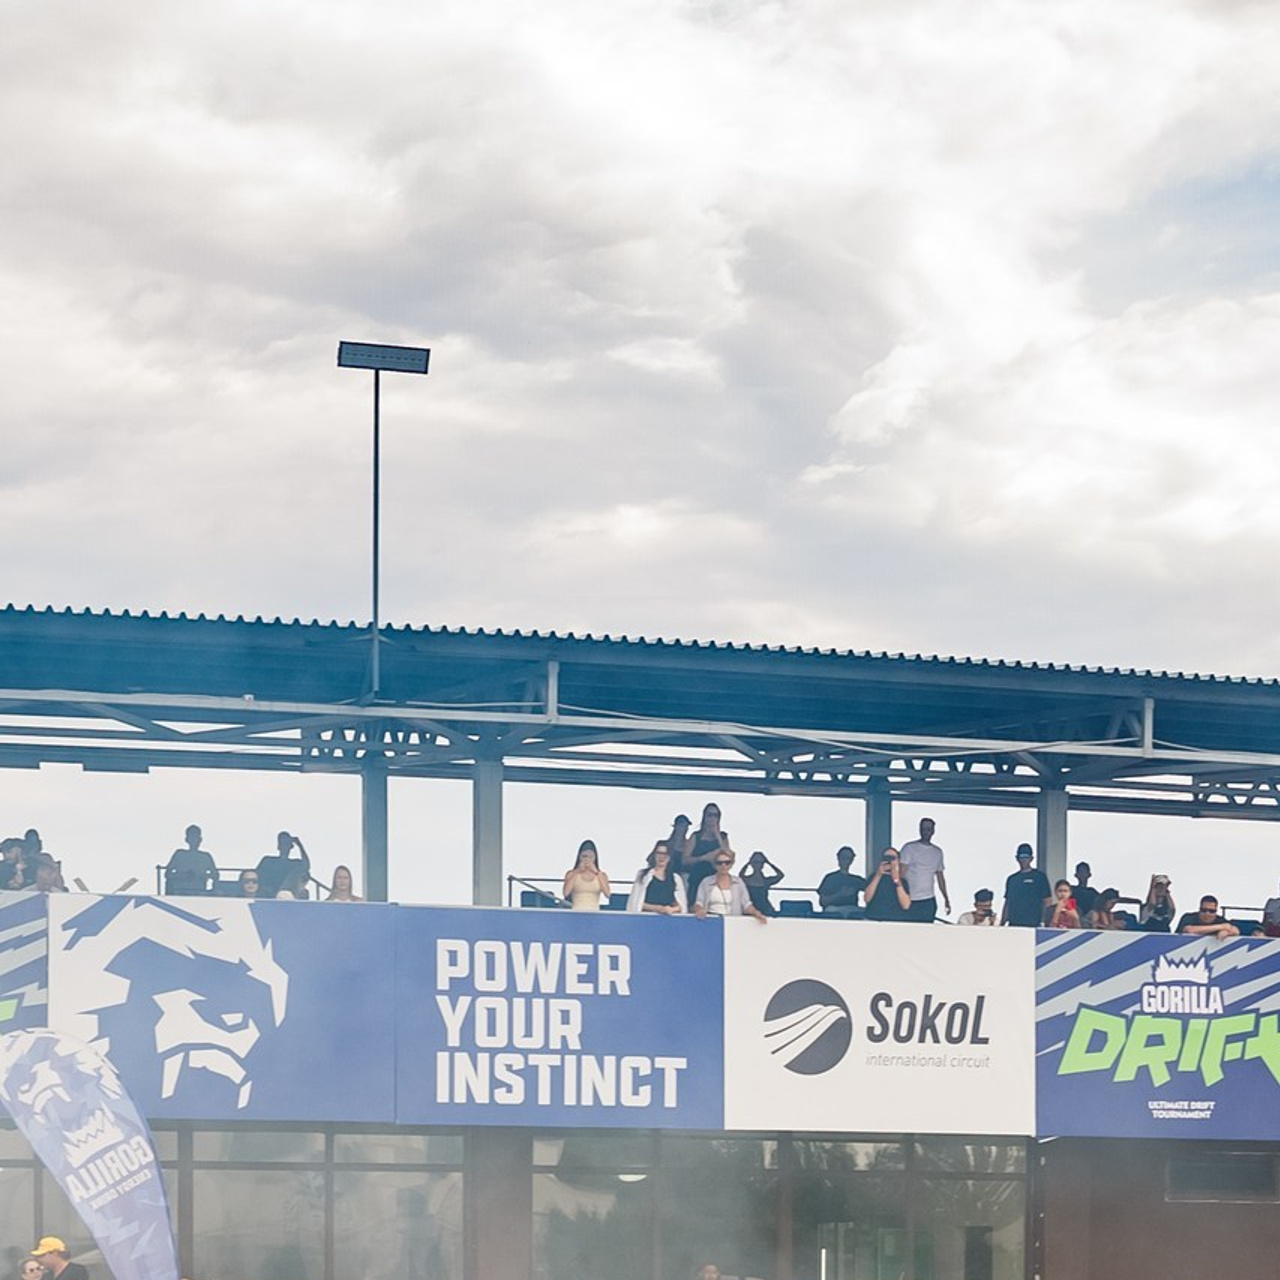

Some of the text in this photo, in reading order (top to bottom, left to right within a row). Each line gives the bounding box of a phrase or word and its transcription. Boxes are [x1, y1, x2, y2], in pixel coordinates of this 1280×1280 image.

[434, 938, 632, 996] POWER
[1141, 984, 1224, 1014] GORILLA
[434, 995, 583, 1050] YOUR
[865, 1054, 991, 1068] international circuit
[434, 1051, 688, 1108] INSTINCT
[1148, 1100, 1217, 1110] ULTIMATE DRIFT
[1151, 1110, 1213, 1119] TOURNAMENT
